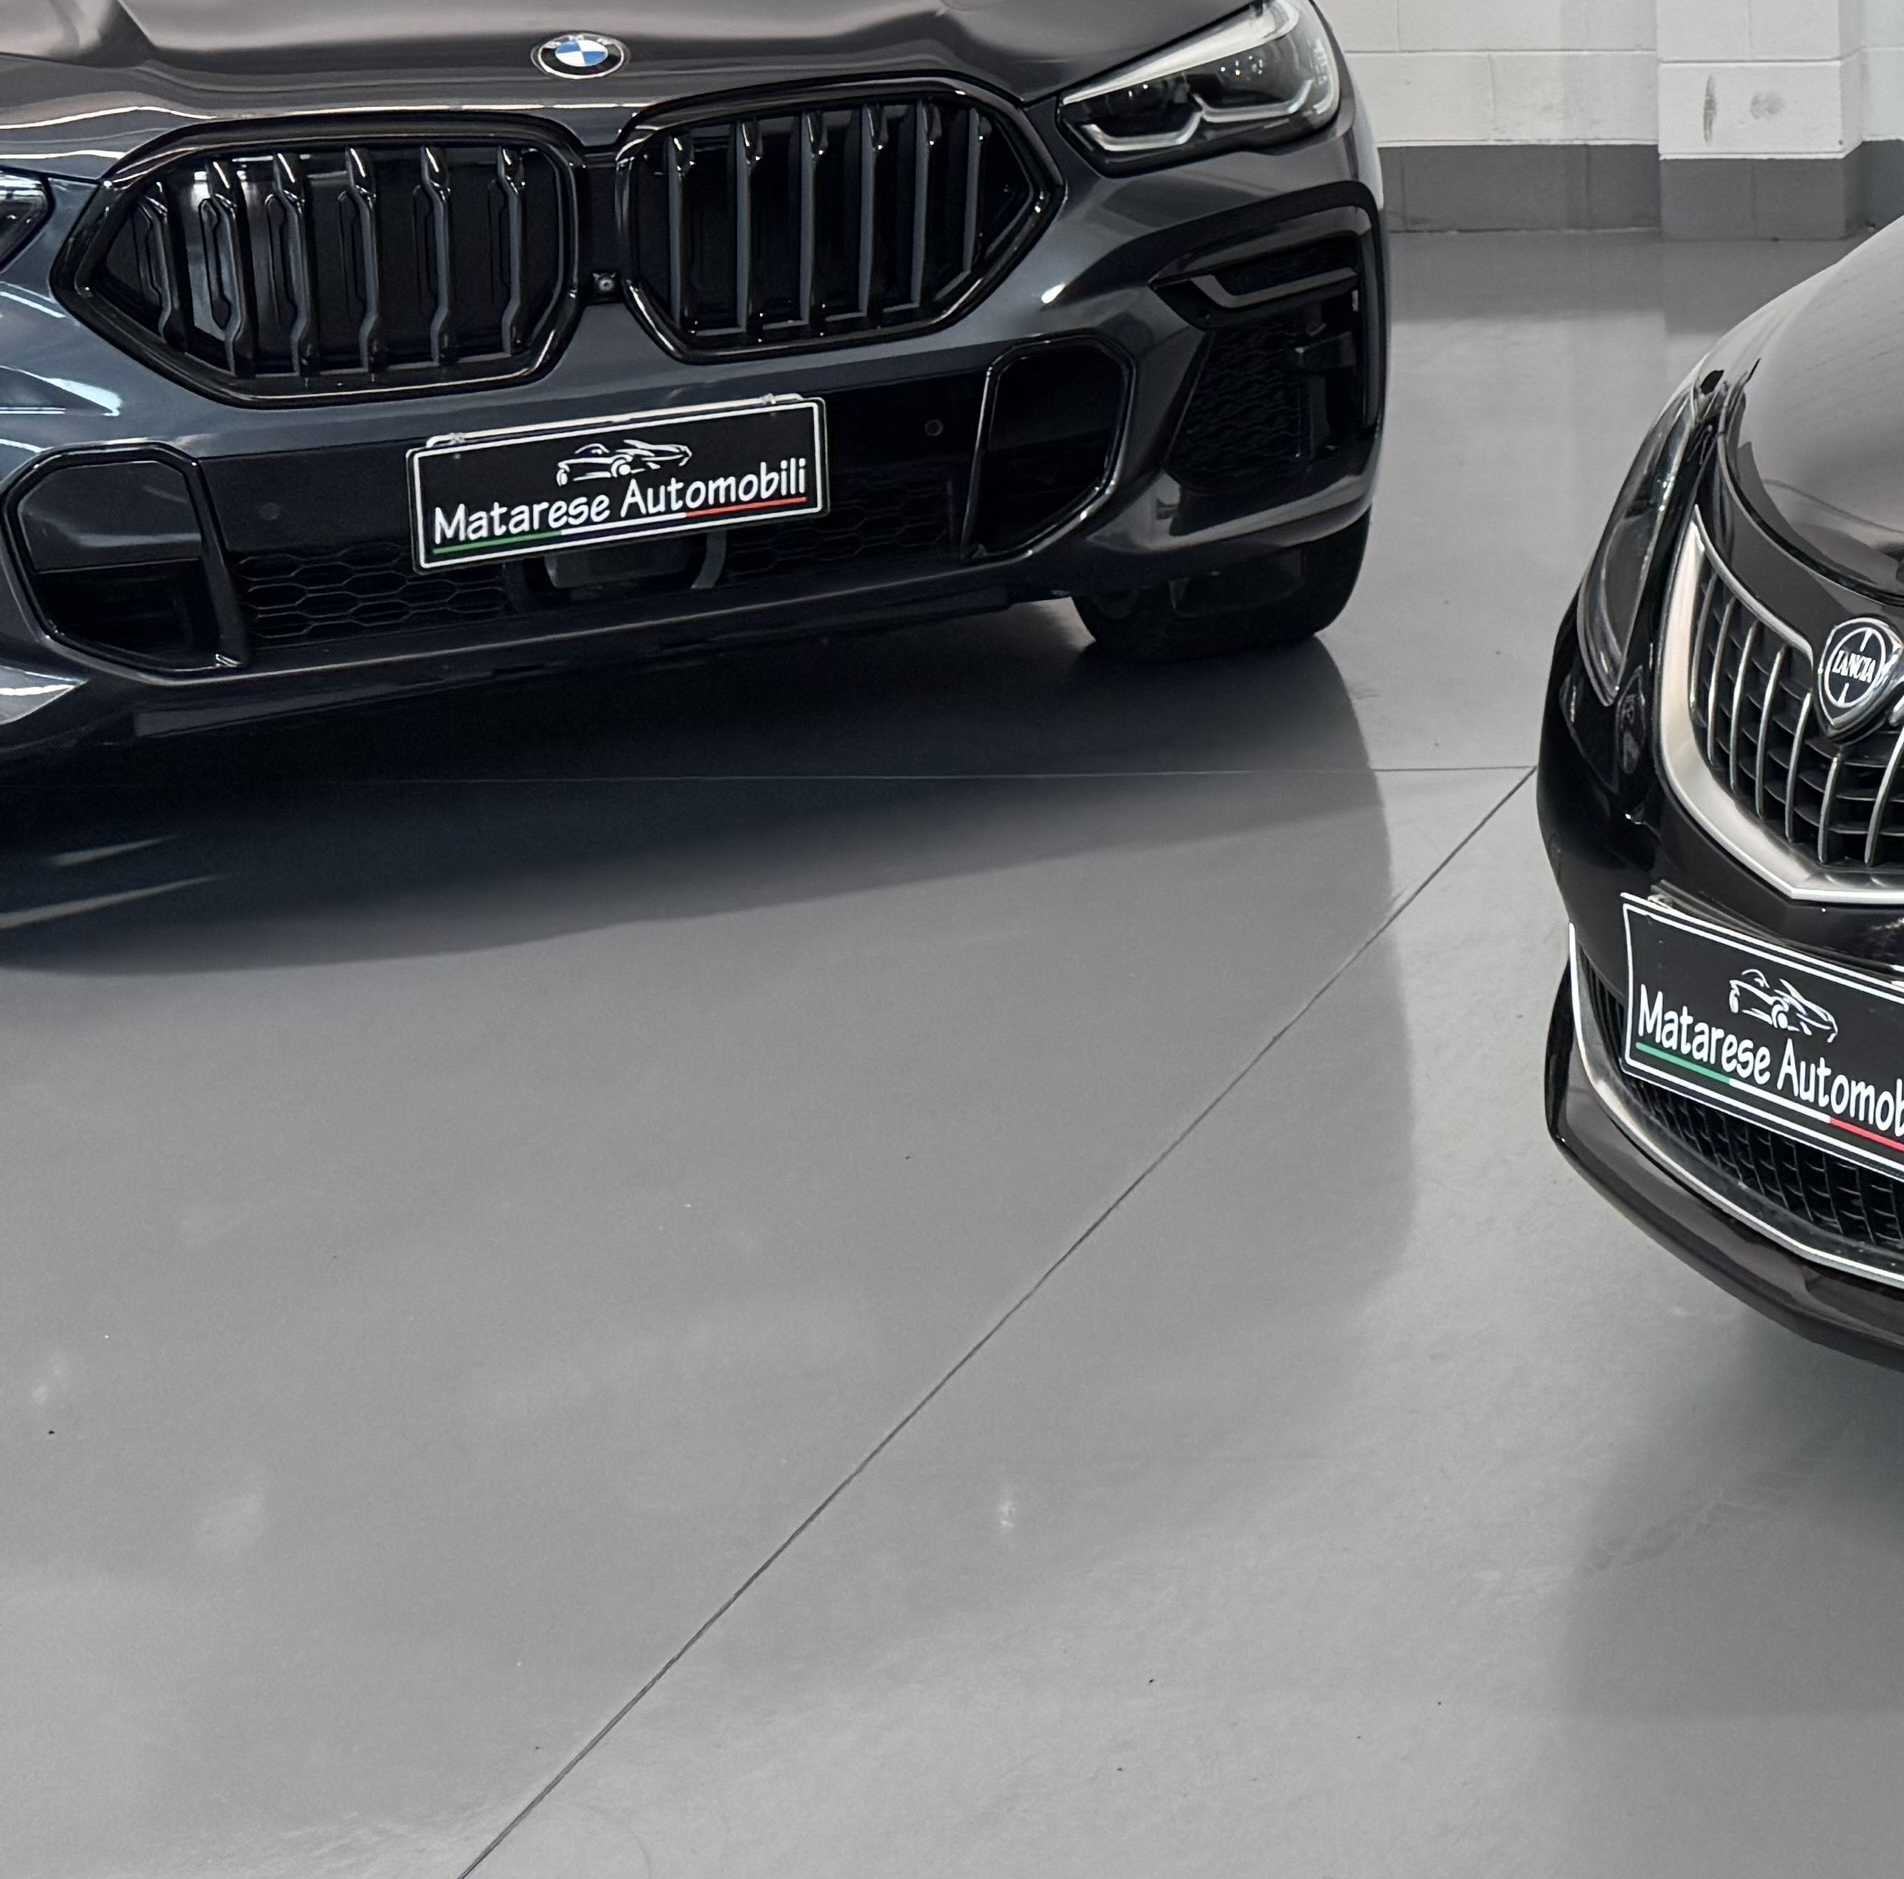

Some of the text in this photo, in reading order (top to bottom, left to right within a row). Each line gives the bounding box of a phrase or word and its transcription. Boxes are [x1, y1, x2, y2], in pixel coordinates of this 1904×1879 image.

[434, 457, 806, 545] Matarese Automobili
[1831, 650, 1877, 684] LANCIA
[1637, 983, 1771, 1086] Matarese
